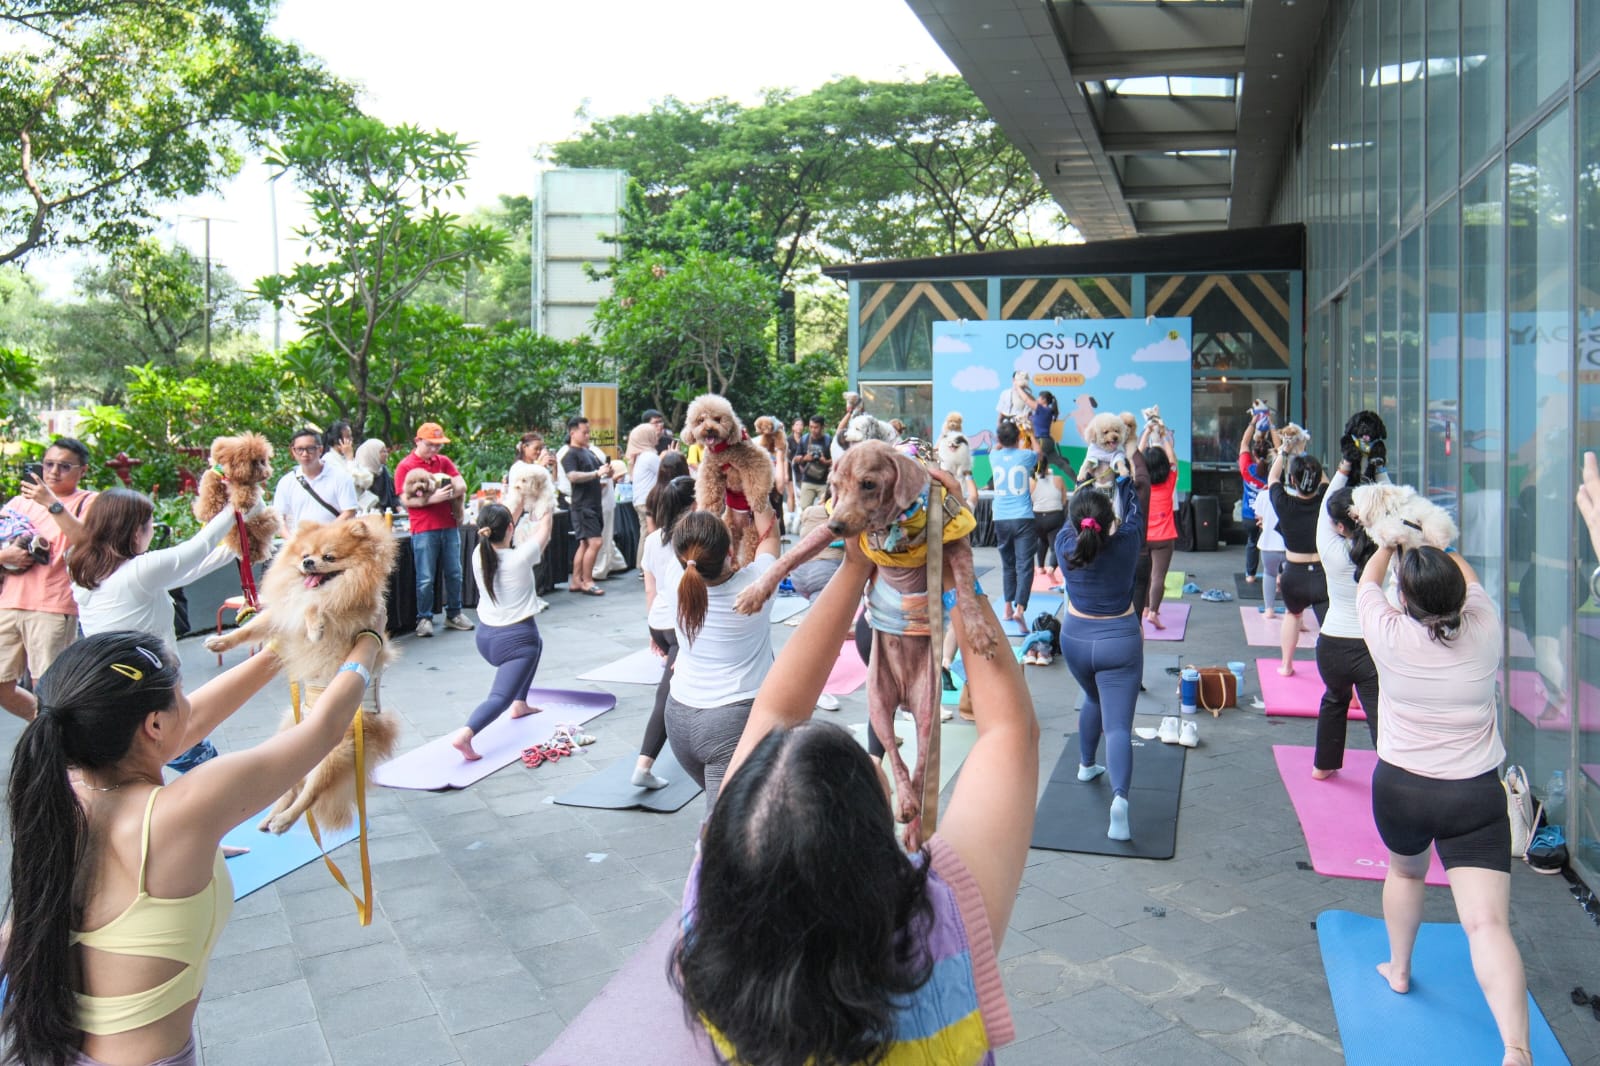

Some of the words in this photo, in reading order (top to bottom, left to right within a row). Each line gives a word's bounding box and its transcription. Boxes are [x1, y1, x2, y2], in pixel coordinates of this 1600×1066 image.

[1006, 333, 1065, 350] DOGS
[1075, 331, 1115, 349] DAY
[1038, 353, 1079, 371] OUT
[993, 465, 1027, 496] 20
